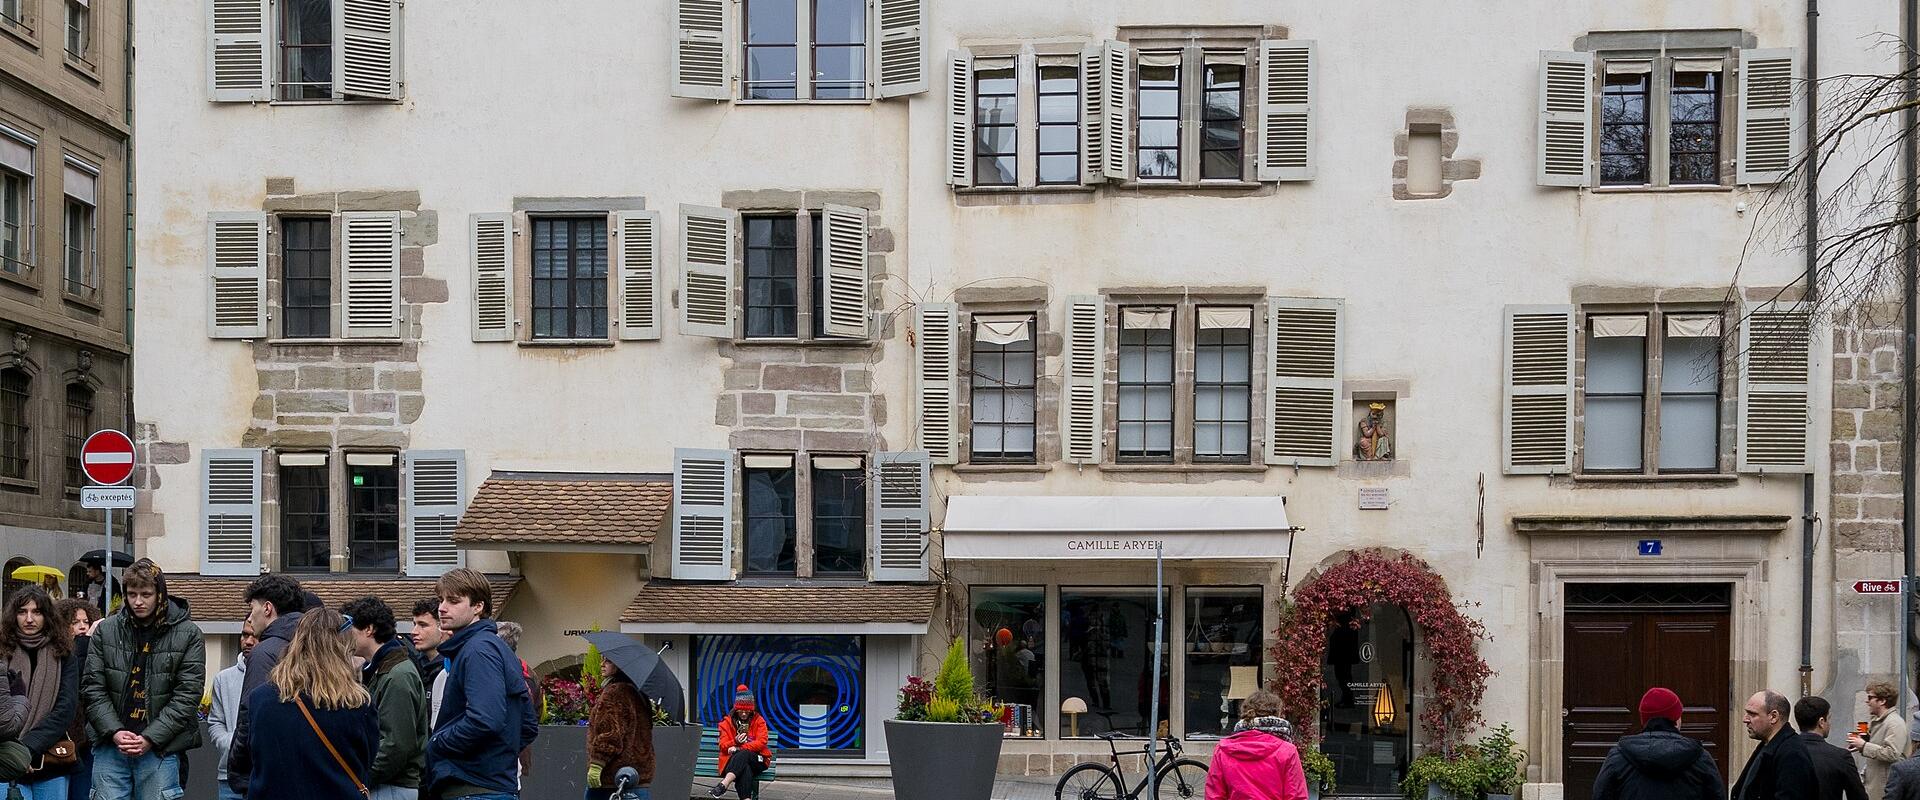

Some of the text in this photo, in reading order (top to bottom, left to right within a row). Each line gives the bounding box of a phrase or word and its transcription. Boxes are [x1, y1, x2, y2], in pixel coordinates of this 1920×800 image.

[100, 493, 133, 502] exceptés
[1067, 540, 1120, 550] CAMILLE
[1646, 542, 1655, 553] 7
[1862, 583, 1882, 592] Rive
